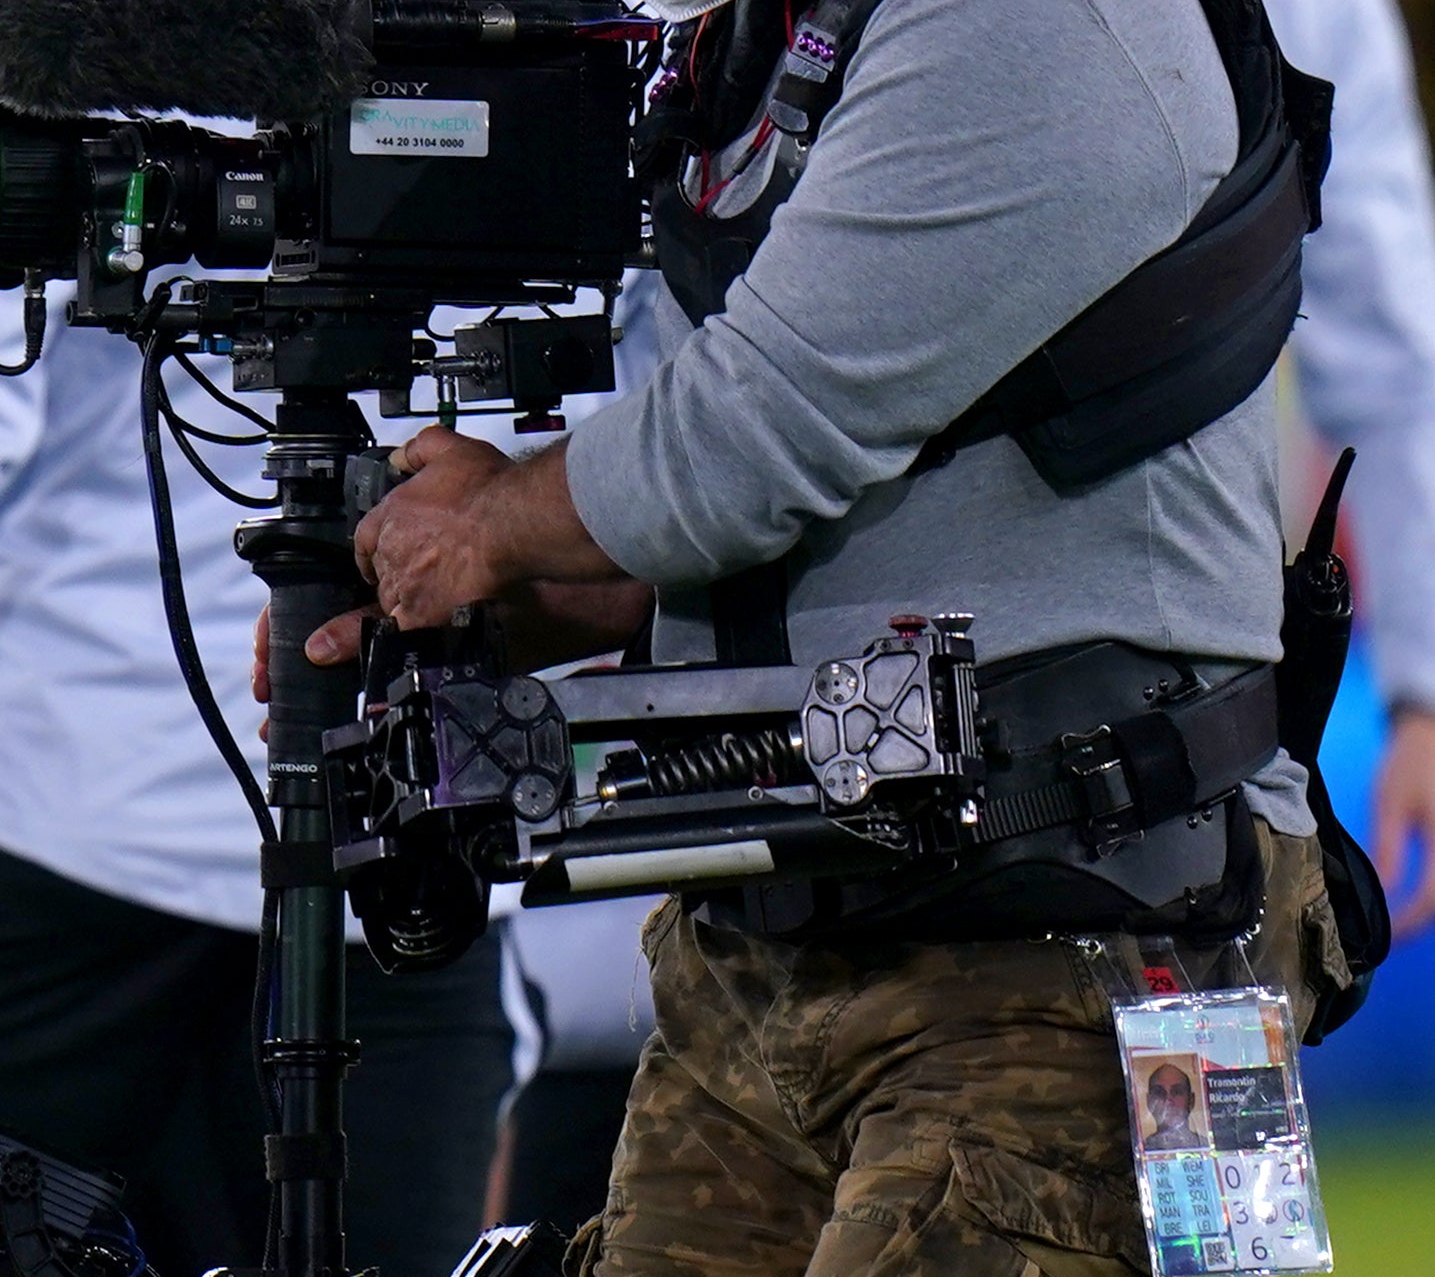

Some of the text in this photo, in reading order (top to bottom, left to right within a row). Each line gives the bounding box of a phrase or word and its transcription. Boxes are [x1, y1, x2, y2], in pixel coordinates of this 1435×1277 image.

[376, 137, 464, 148] +44 20 3104 0000
[225, 171, 264, 181] Canon
[269, 763, 318, 773] ARTENGO
[1147, 976, 1174, 992] 29
[1225, 1165, 1241, 1189] 0
[1279, 1162, 1295, 1186] 2
[1186, 1175, 1205, 1187] SHE
[1189, 1190, 1208, 1202] SOU
[1159, 1207, 1181, 1218] MAN
[1192, 1204, 1210, 1217] TRA
[1233, 1201, 1249, 1225] 3
[1197, 1220, 1211, 1233] LEI
[1251, 1237, 1268, 1261] 6
